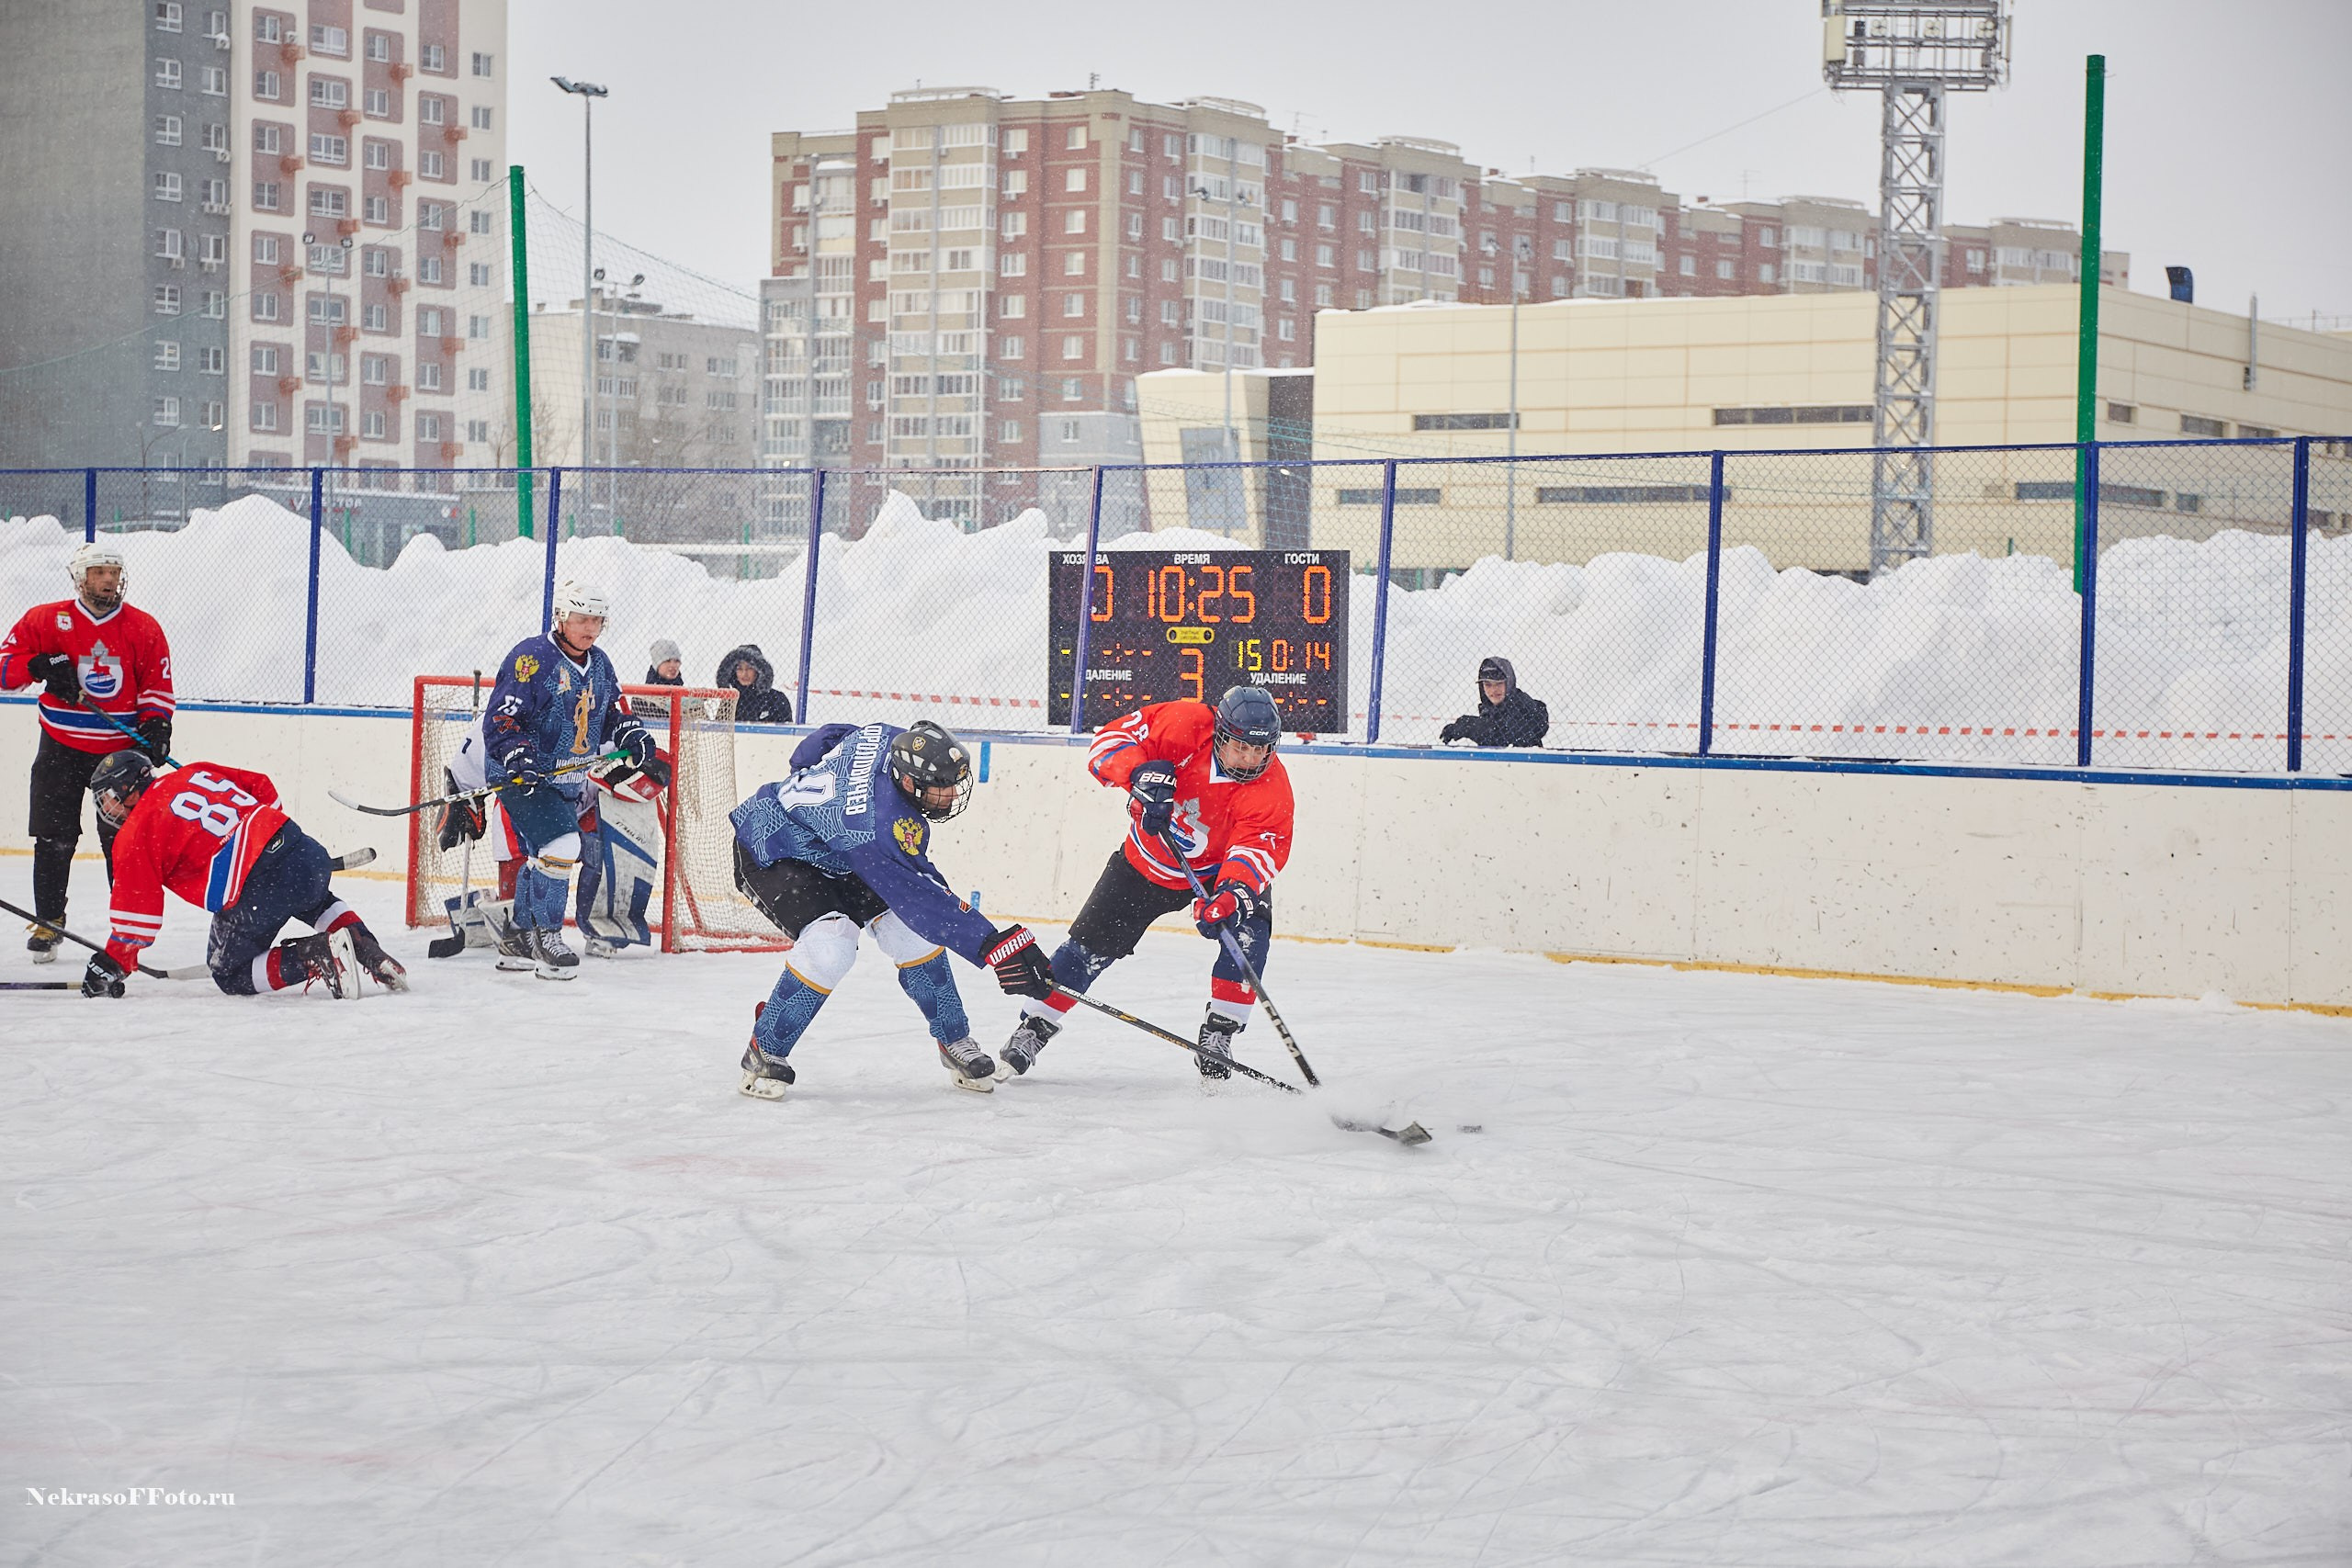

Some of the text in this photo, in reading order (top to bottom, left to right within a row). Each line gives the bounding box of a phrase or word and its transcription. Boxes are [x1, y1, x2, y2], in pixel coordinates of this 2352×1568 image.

[1062, 554, 1109, 564] ХОЗВА
[1173, 554, 1211, 564] ВРЕМЯ
[1284, 553, 1320, 564] ГОСТИ
[1148, 566, 1256, 623] 10:25
[1303, 566, 1331, 624] 0
[1238, 639, 1262, 671] 15
[1272, 639, 1330, 671] 0:14
[1085, 669, 1133, 682] ДАЛЕНИЕ
[1180, 648, 1204, 704] 3
[1250, 671, 1307, 685] УДАЛЕНИЕ
[1138, 772, 1177, 787] BAU
[443, 786, 489, 803] CCM
[168, 770, 258, 838] 85
